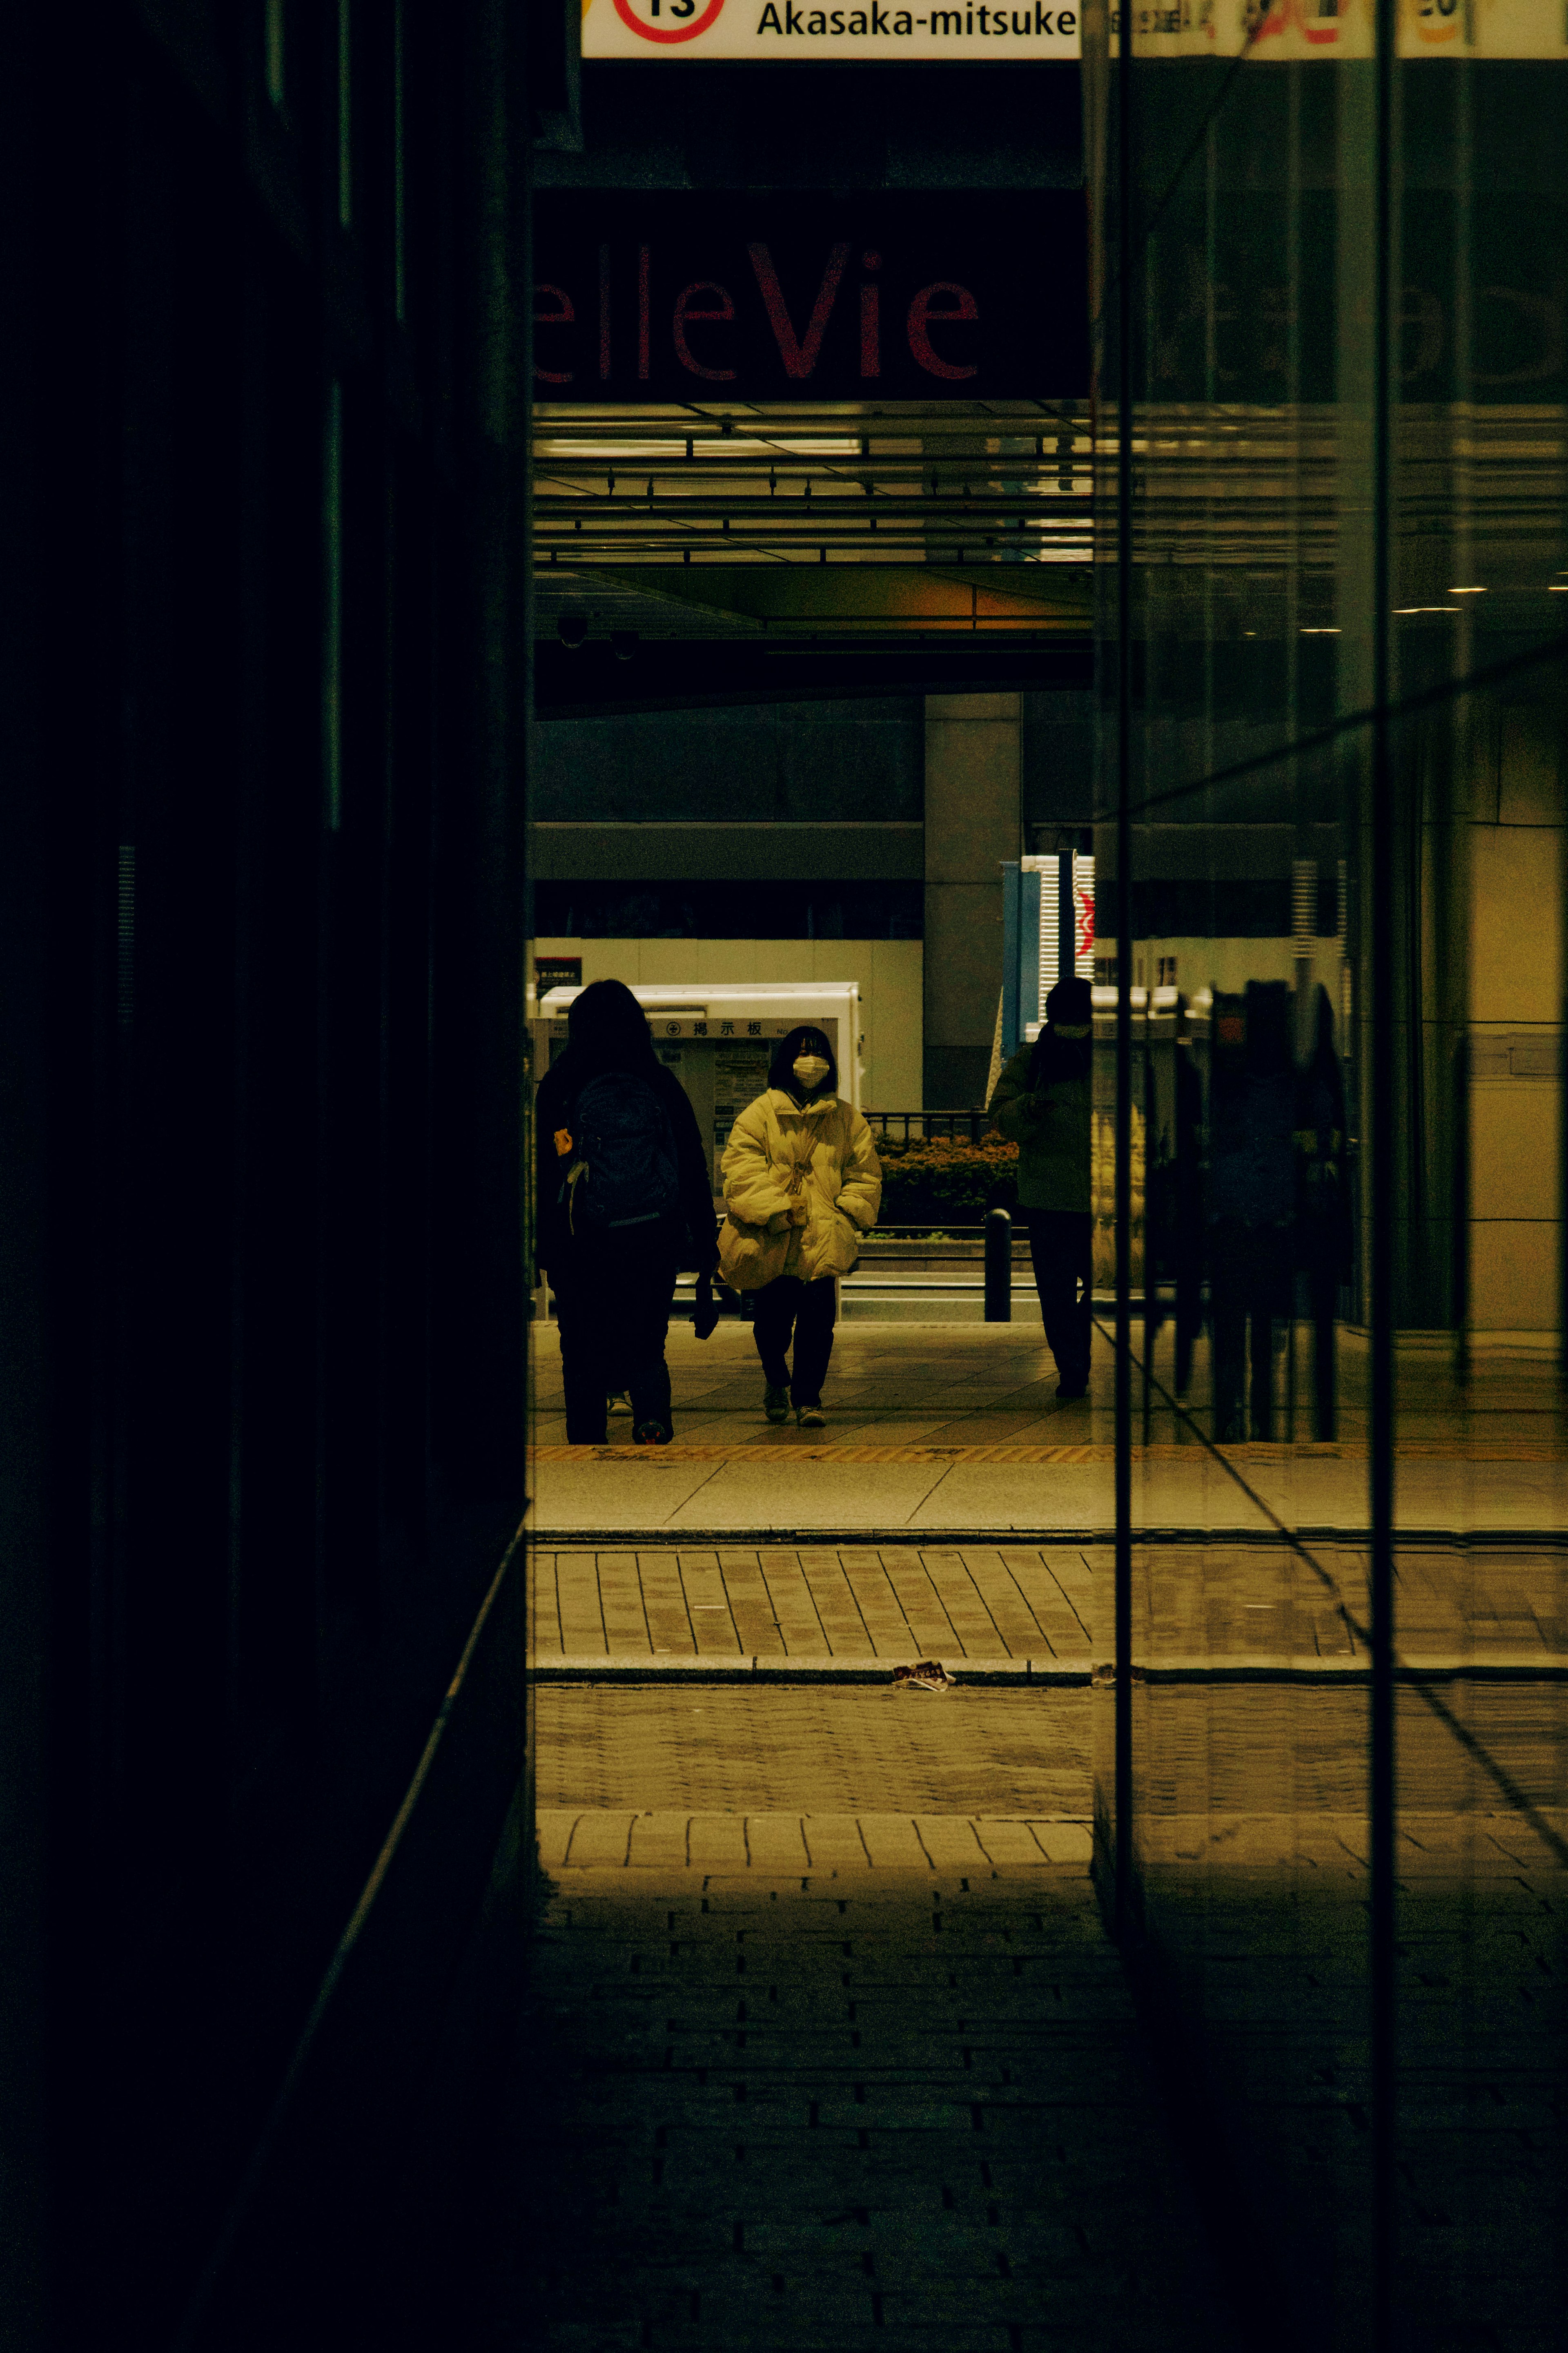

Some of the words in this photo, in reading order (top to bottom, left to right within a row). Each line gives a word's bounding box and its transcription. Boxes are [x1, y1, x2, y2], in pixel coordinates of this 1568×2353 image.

[757, 1, 1076, 35] Akasaka-mitsuke
[693, 1022, 762, 1036] 掲示板
